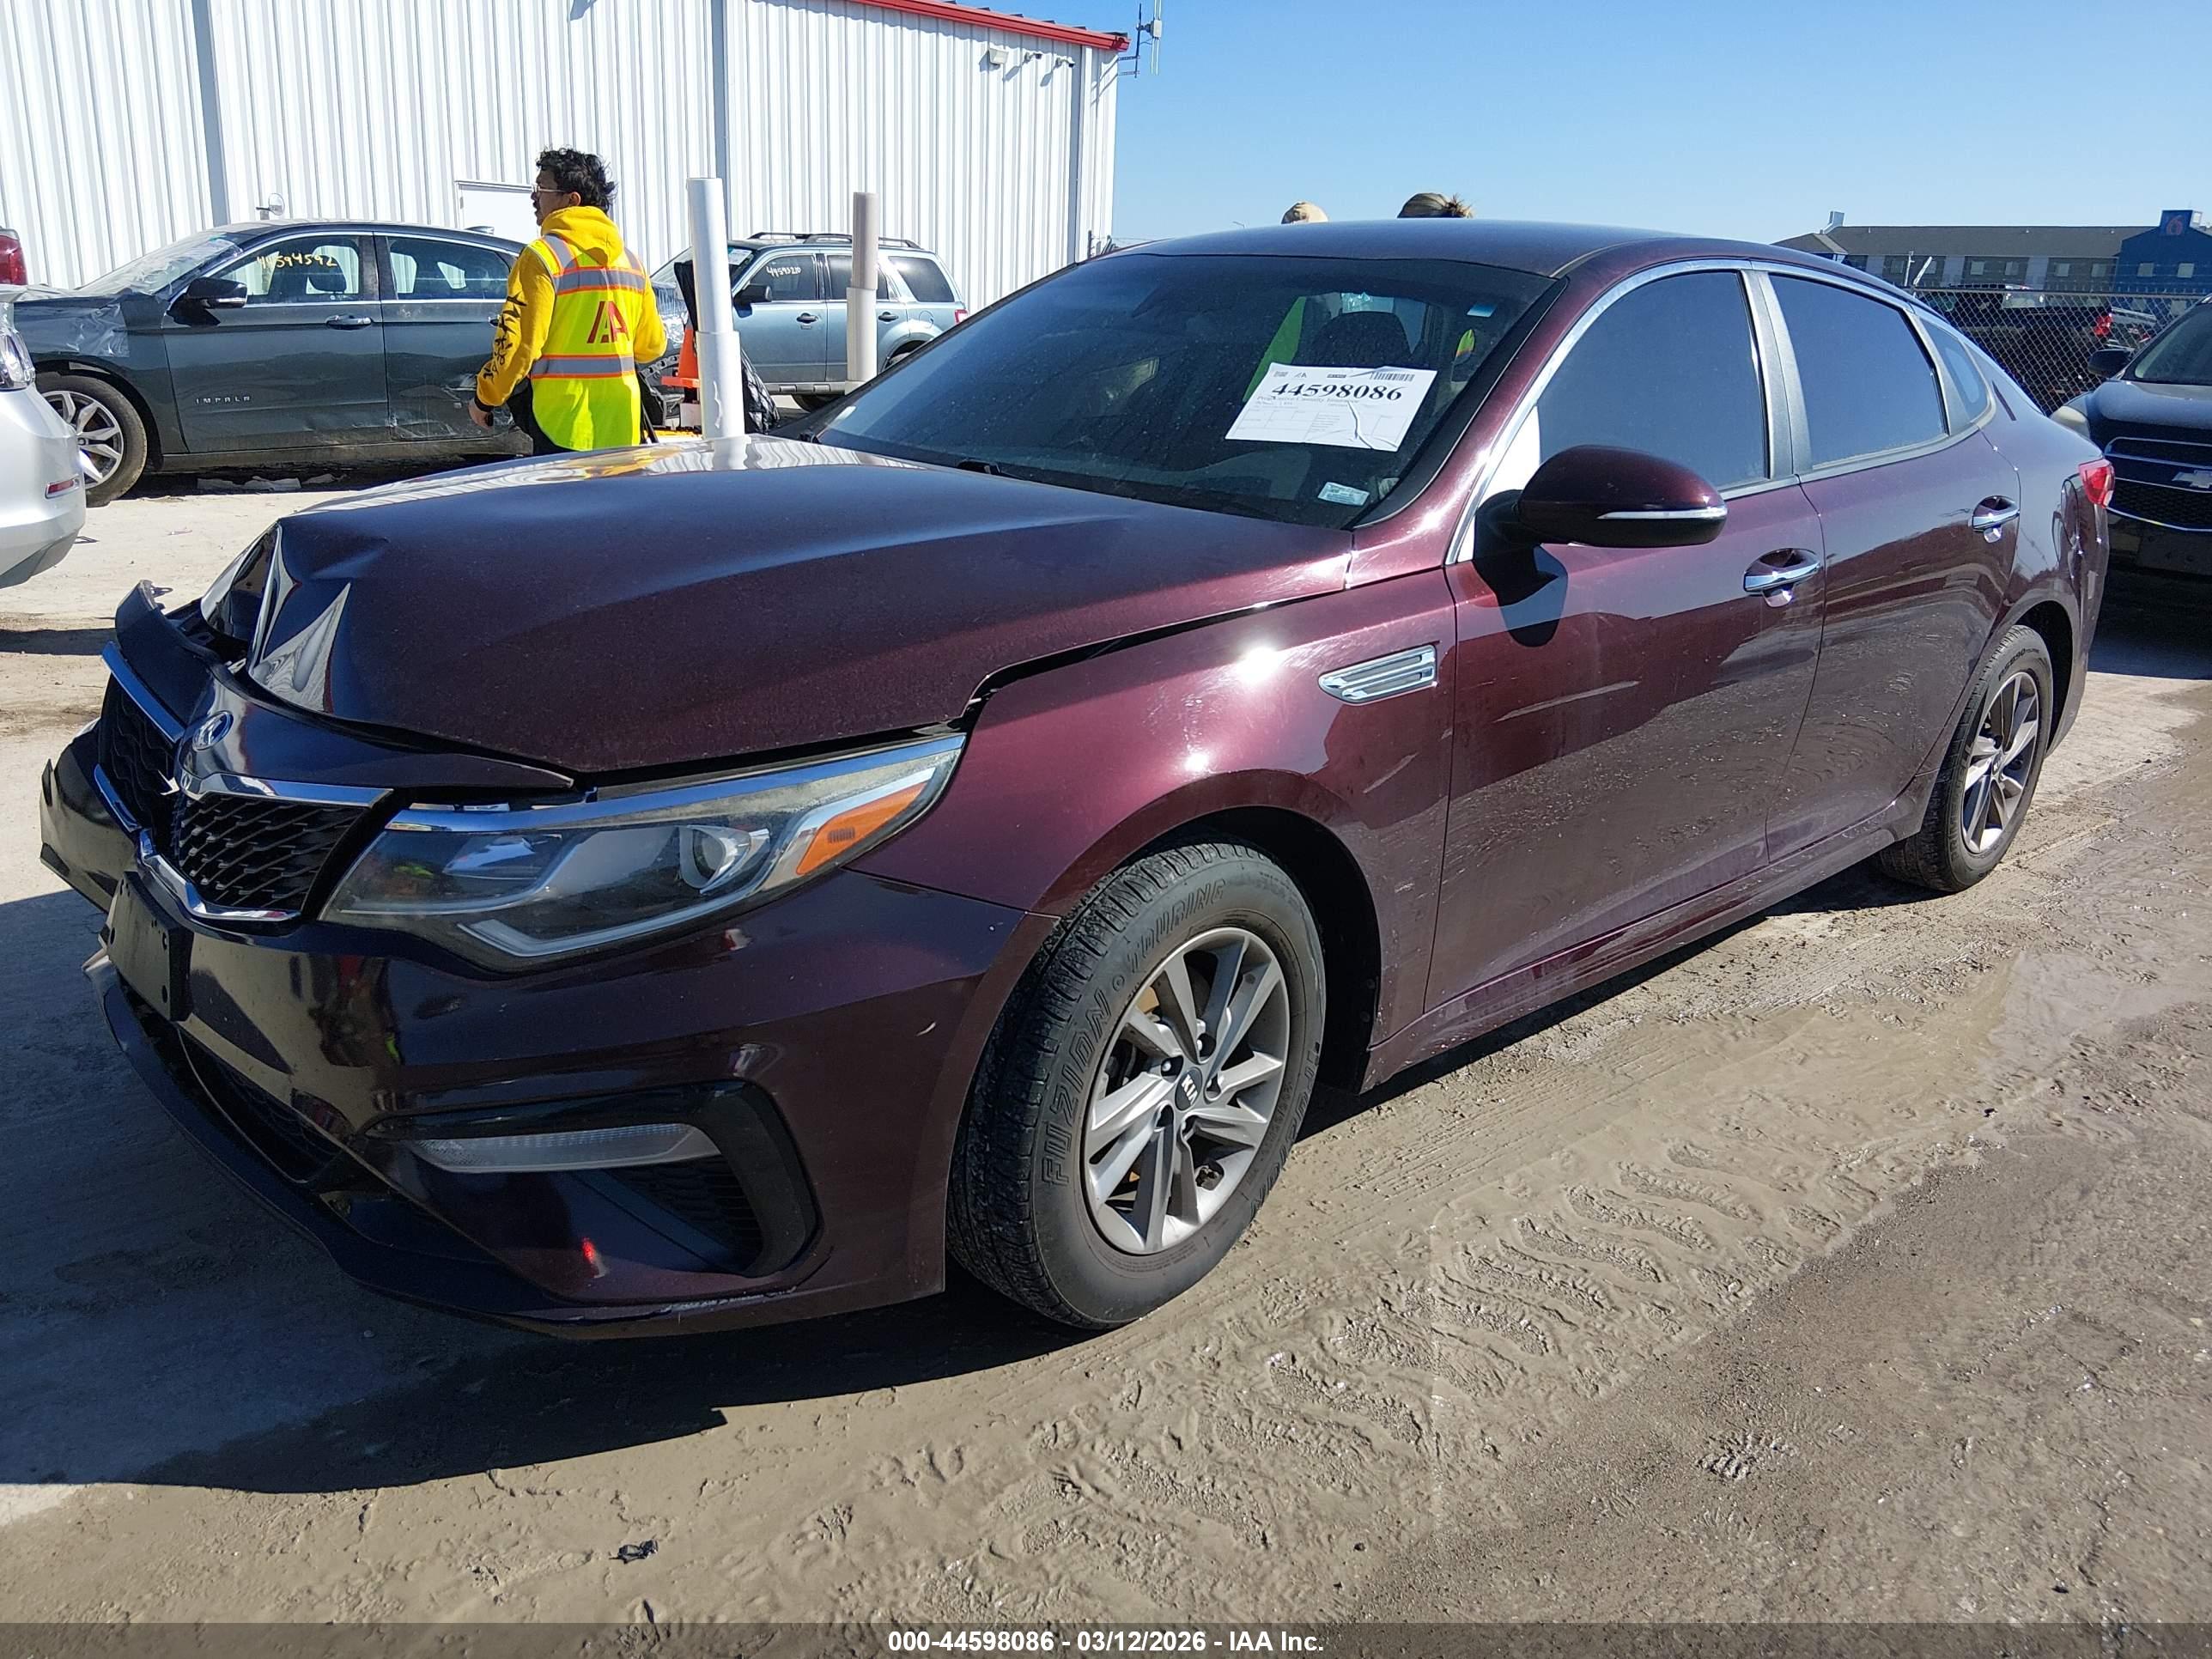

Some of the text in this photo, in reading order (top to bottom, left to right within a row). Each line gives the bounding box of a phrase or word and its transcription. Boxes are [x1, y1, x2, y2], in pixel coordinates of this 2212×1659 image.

[196, 396, 250, 404] IMPALA
[1272, 383, 1408, 401] 44598086
[1042, 878, 1226, 1186] FUZION TOURING
[1181, 1073, 1199, 1106] KIA
